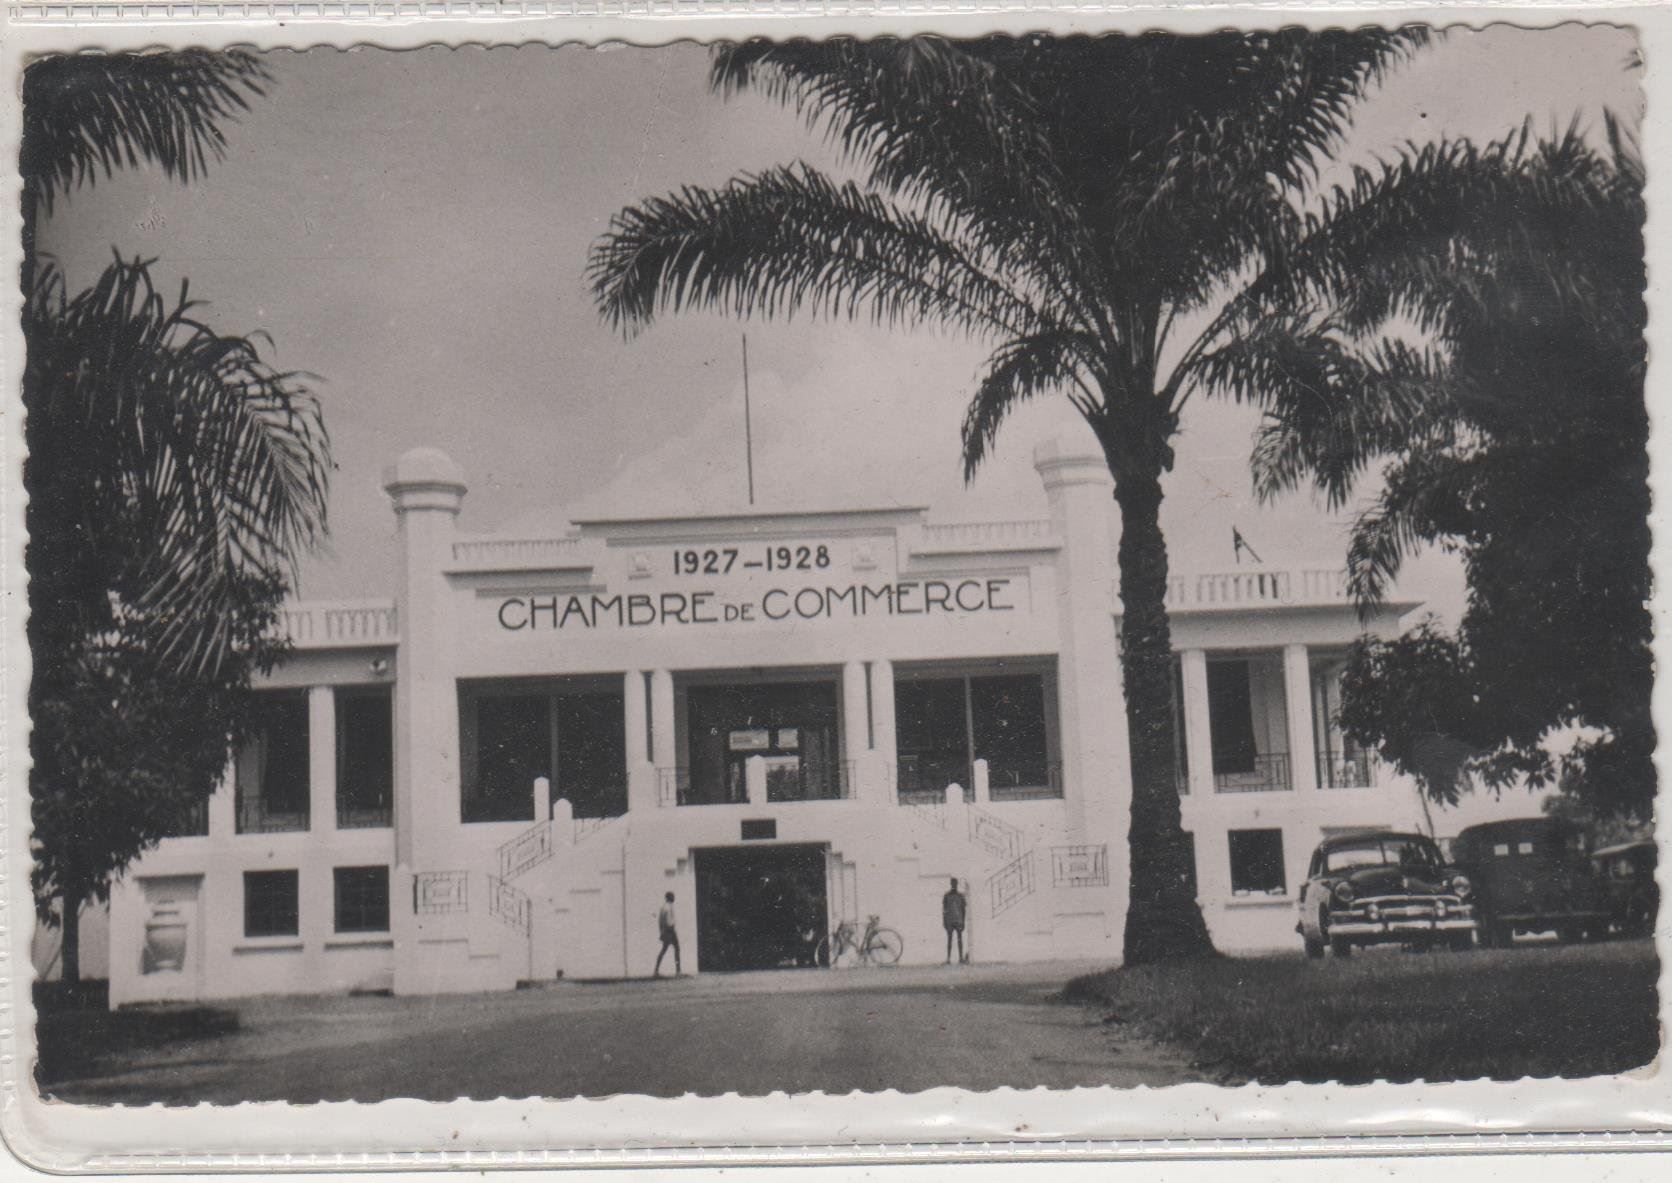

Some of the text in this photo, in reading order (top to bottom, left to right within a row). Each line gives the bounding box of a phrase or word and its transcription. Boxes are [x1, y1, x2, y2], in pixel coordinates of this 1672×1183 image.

[497, 579, 1014, 631] CHAMBRE DE COMMERCE
